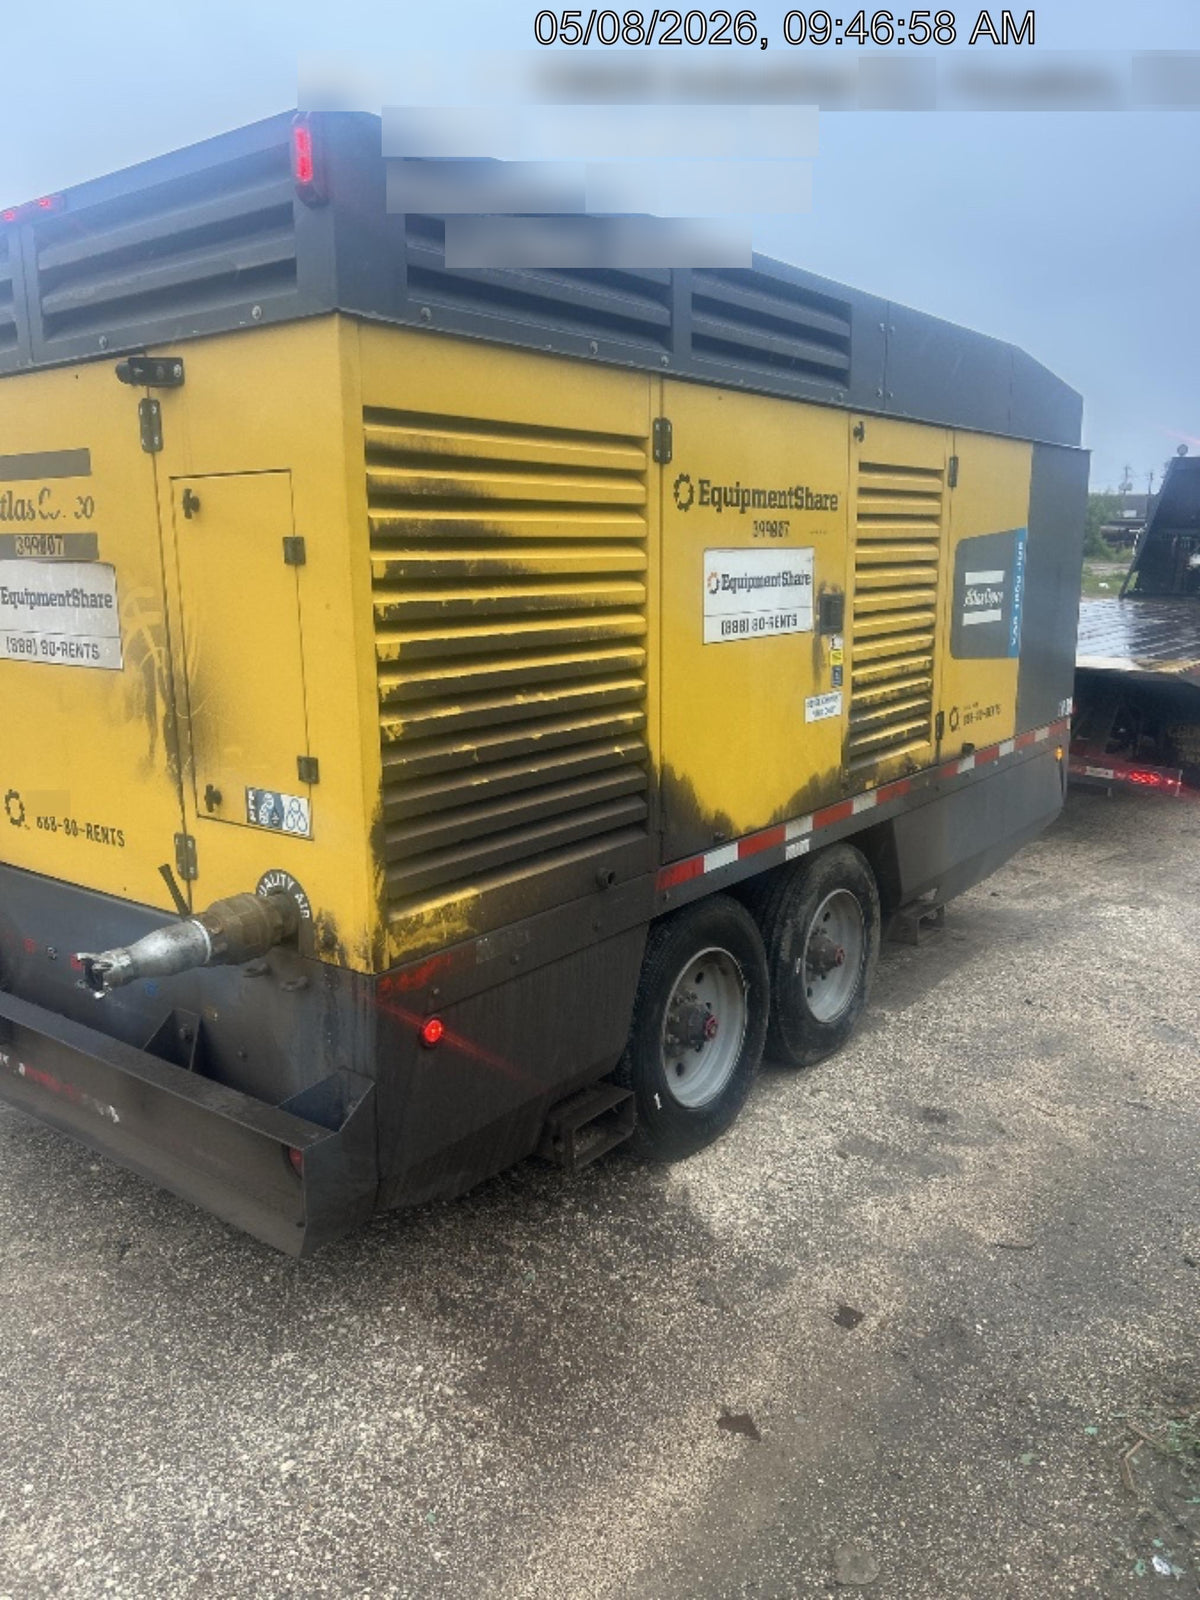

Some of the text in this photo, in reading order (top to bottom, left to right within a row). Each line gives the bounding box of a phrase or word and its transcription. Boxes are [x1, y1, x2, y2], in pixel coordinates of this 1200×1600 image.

[698, 479, 839, 514] EquipmentShare
[721, 571, 812, 595] EquipmentShare
[0, 586, 113, 610] EquipmentShare
